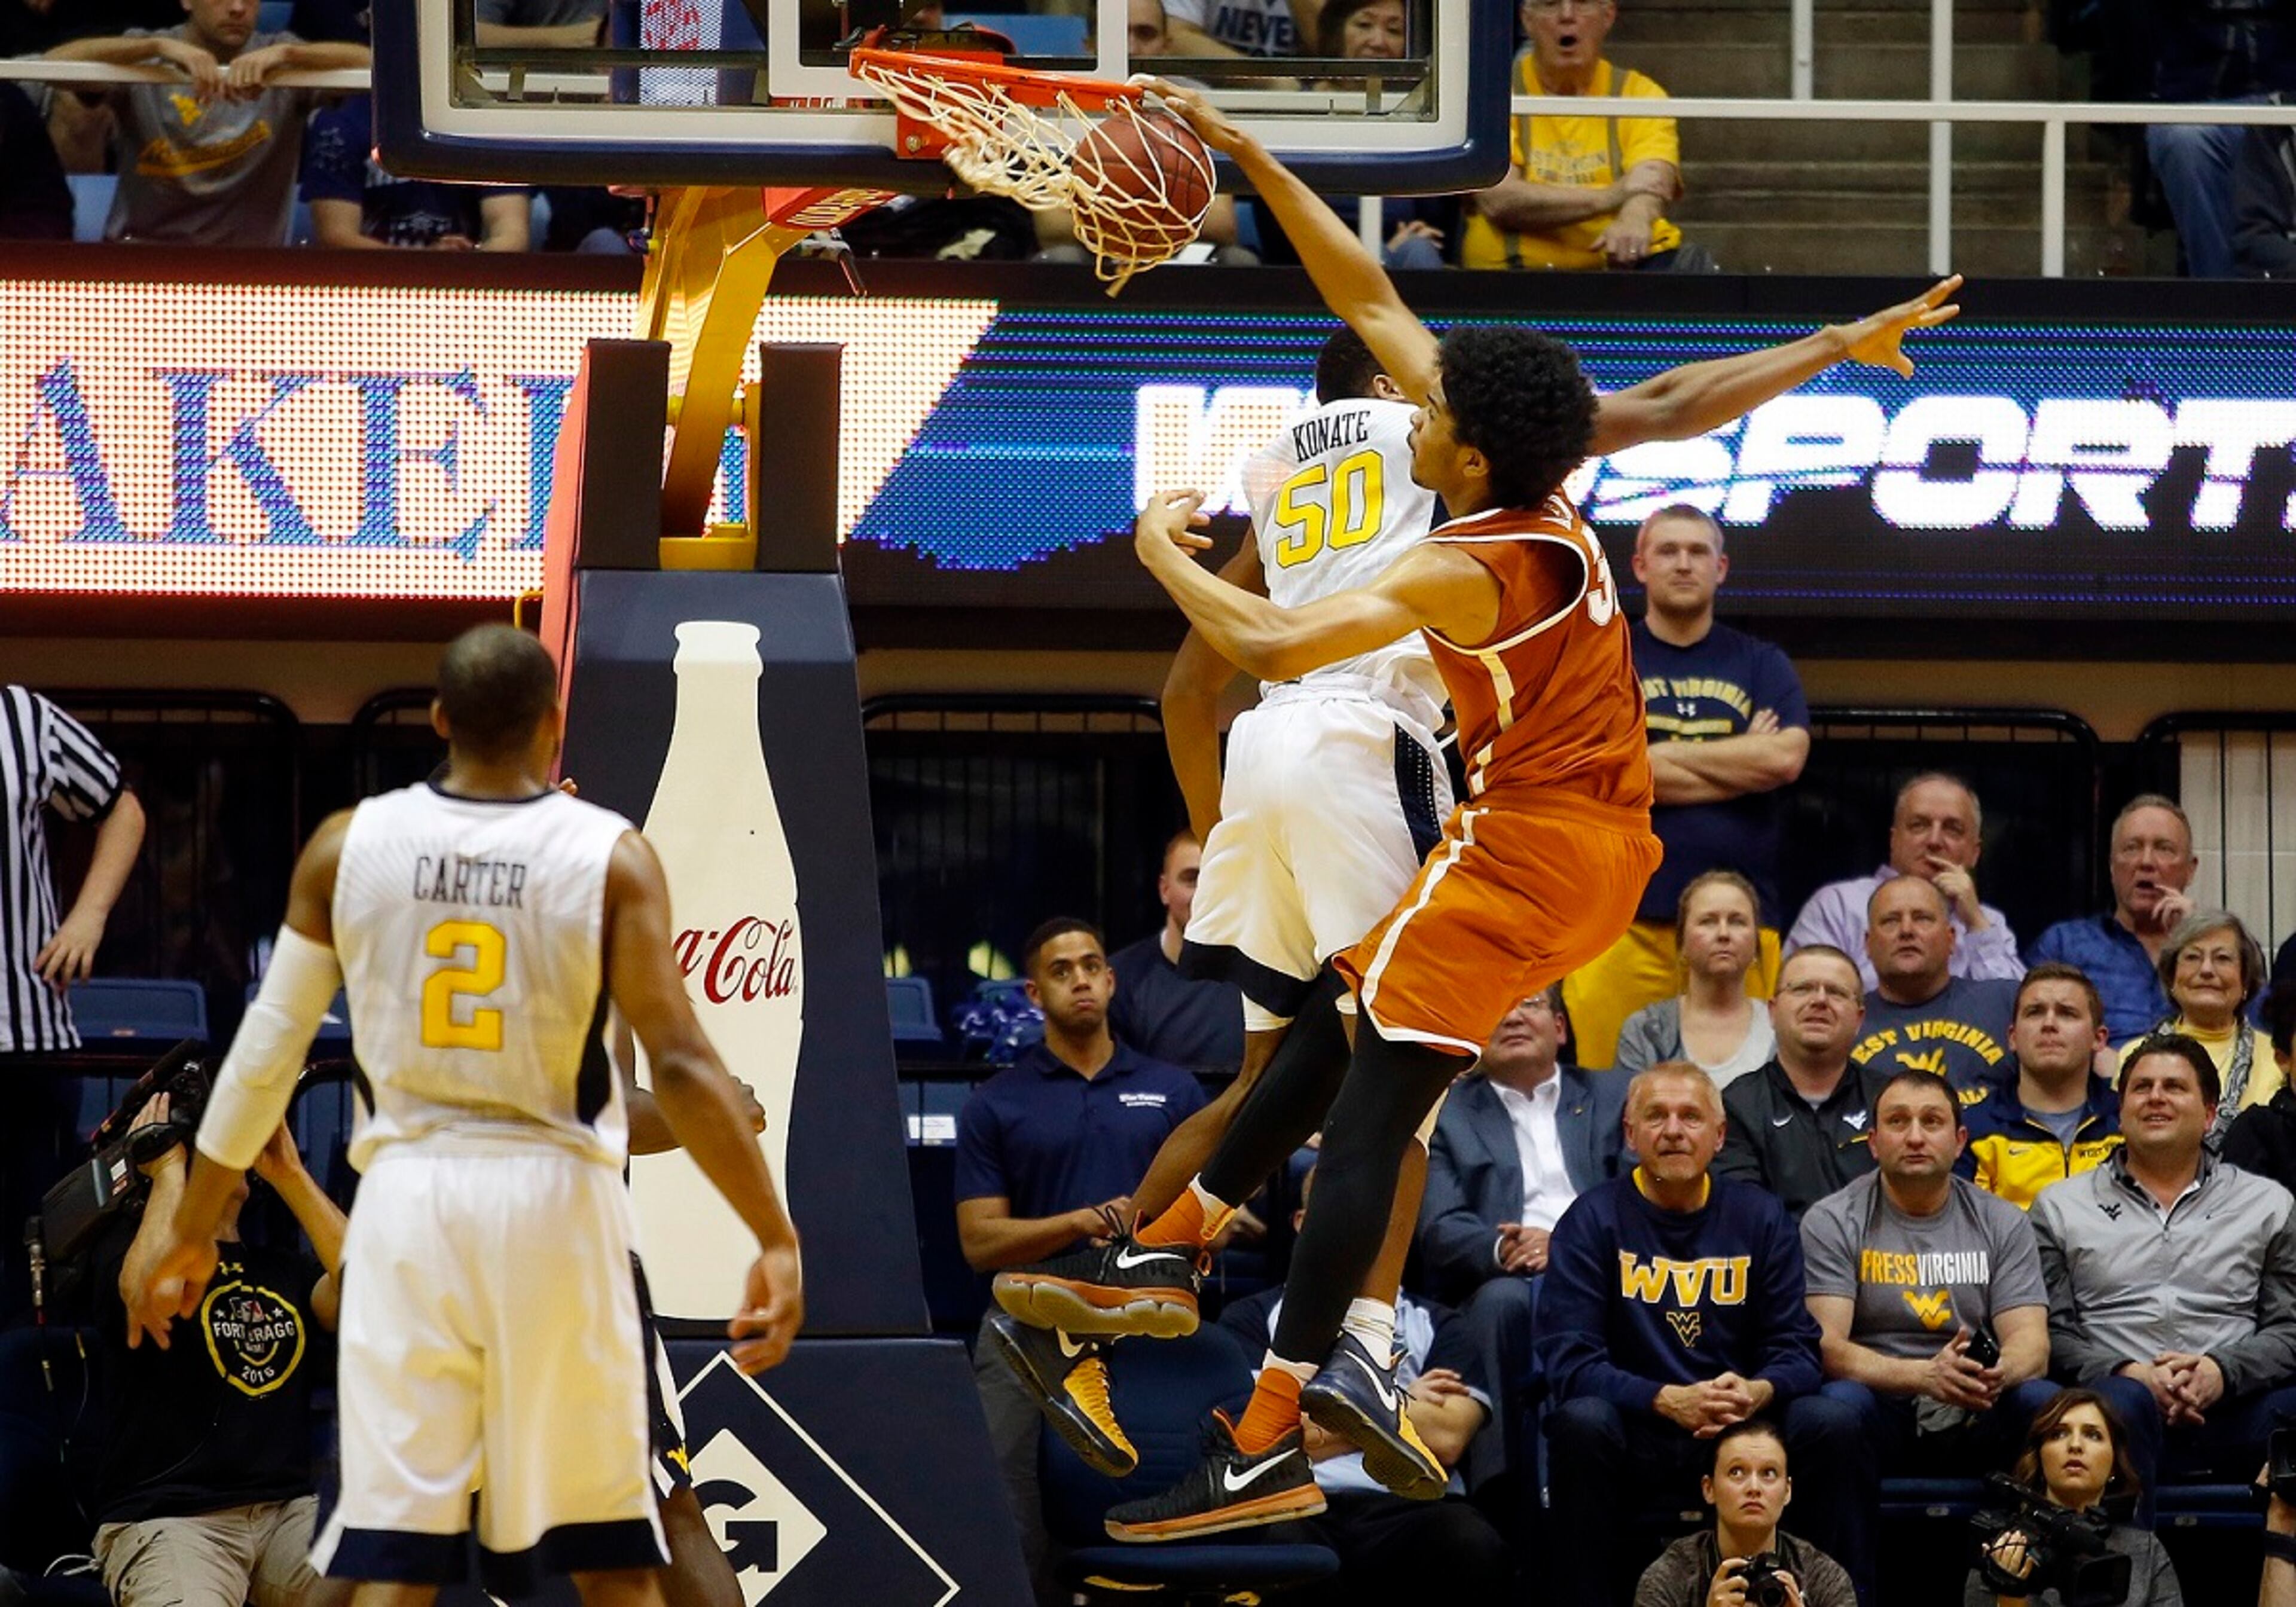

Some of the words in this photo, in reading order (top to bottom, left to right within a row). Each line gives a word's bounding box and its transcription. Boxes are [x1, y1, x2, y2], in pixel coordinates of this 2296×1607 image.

[1214, 7, 1297, 48] NEVE
[0, 357, 573, 563] AKE
[1135, 385, 2296, 531] WSPORT
[1292, 410, 1370, 463] KONATE
[1275, 449, 1384, 569] 50
[1581, 524, 1620, 627] 3
[413, 856, 527, 909] CARTER
[420, 919, 507, 1053] 2
[672, 916, 795, 1005] a-Cola
[1850, 1028, 1898, 1065] EST
[1904, 1021, 2004, 1067] VIRGINIA
[1618, 1249, 1751, 1307] WVU
